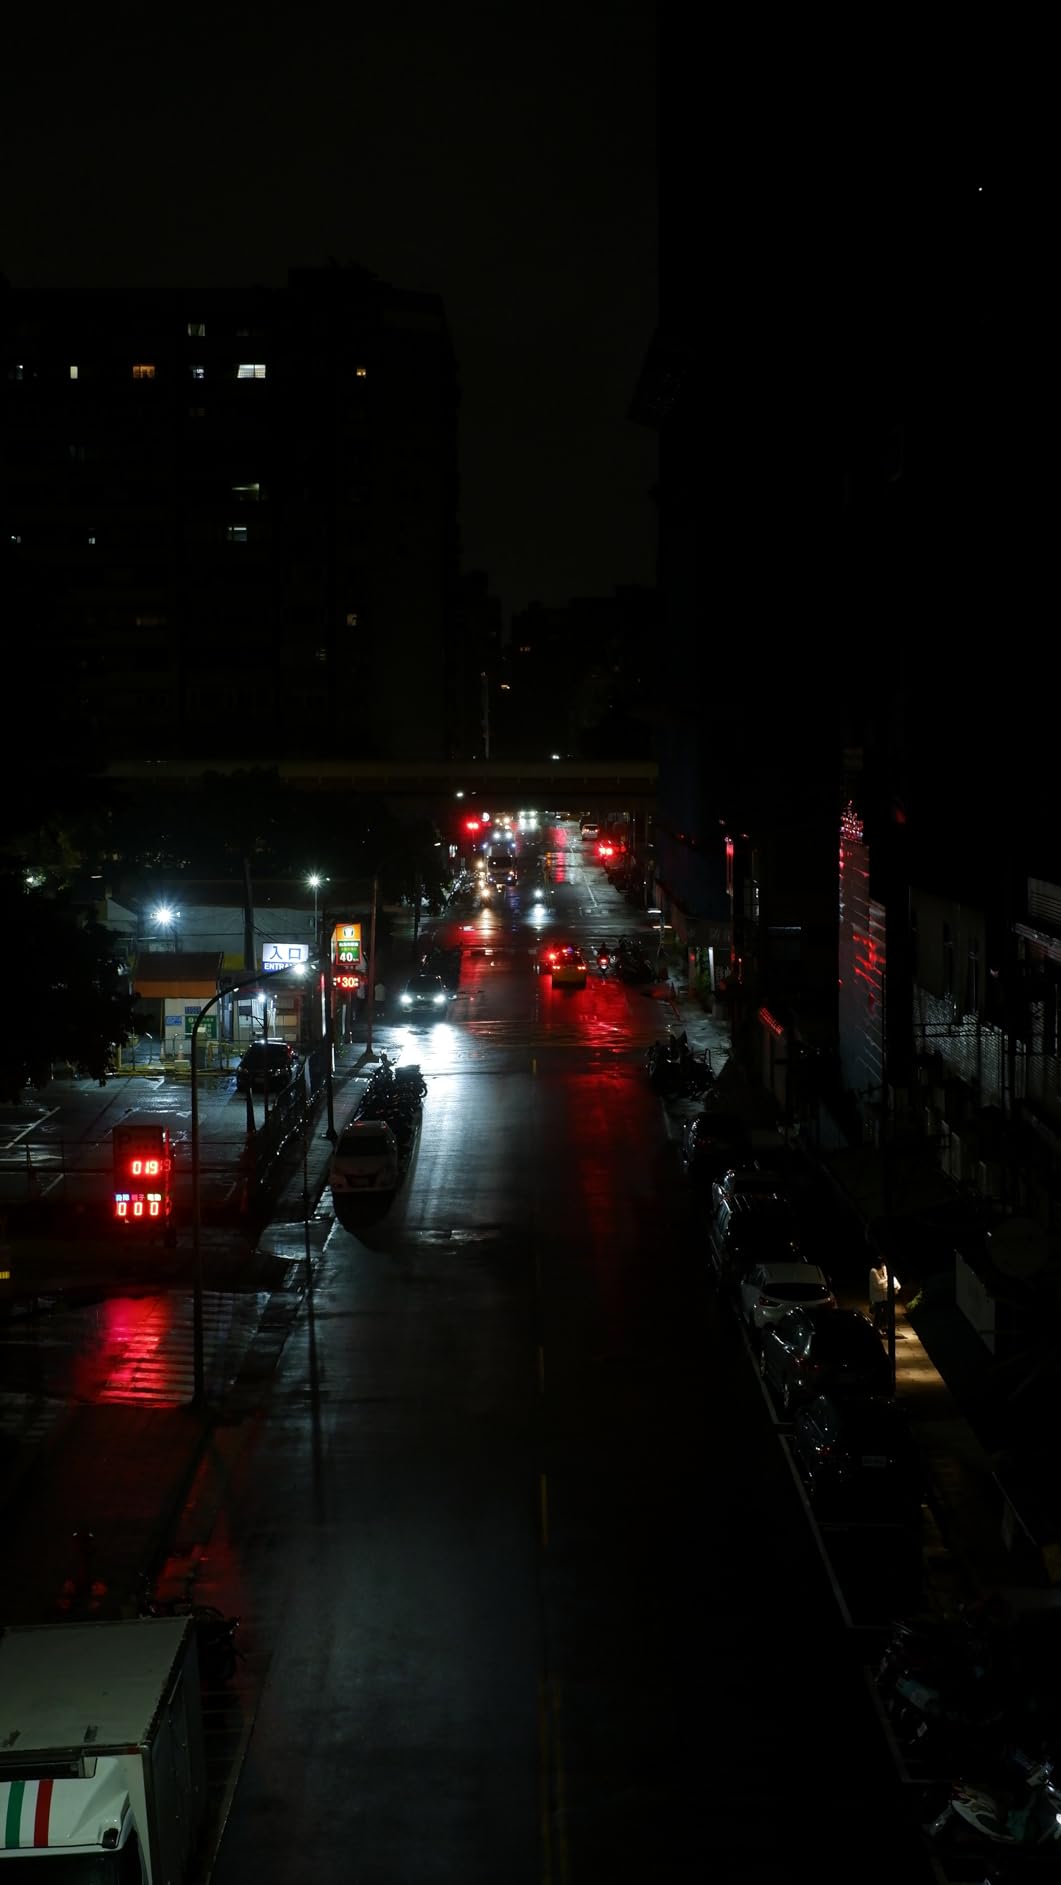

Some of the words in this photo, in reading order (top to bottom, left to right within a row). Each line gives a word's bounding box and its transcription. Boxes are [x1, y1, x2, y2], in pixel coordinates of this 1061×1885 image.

[269, 945, 301, 960] 入口
[339, 952, 353, 962] 40
[342, 976, 355, 988] 30
[132, 1160, 159, 1175] 019
[118, 1202, 127, 1216] 0
[134, 1202, 143, 1216] 0
[150, 1202, 159, 1216] 0
